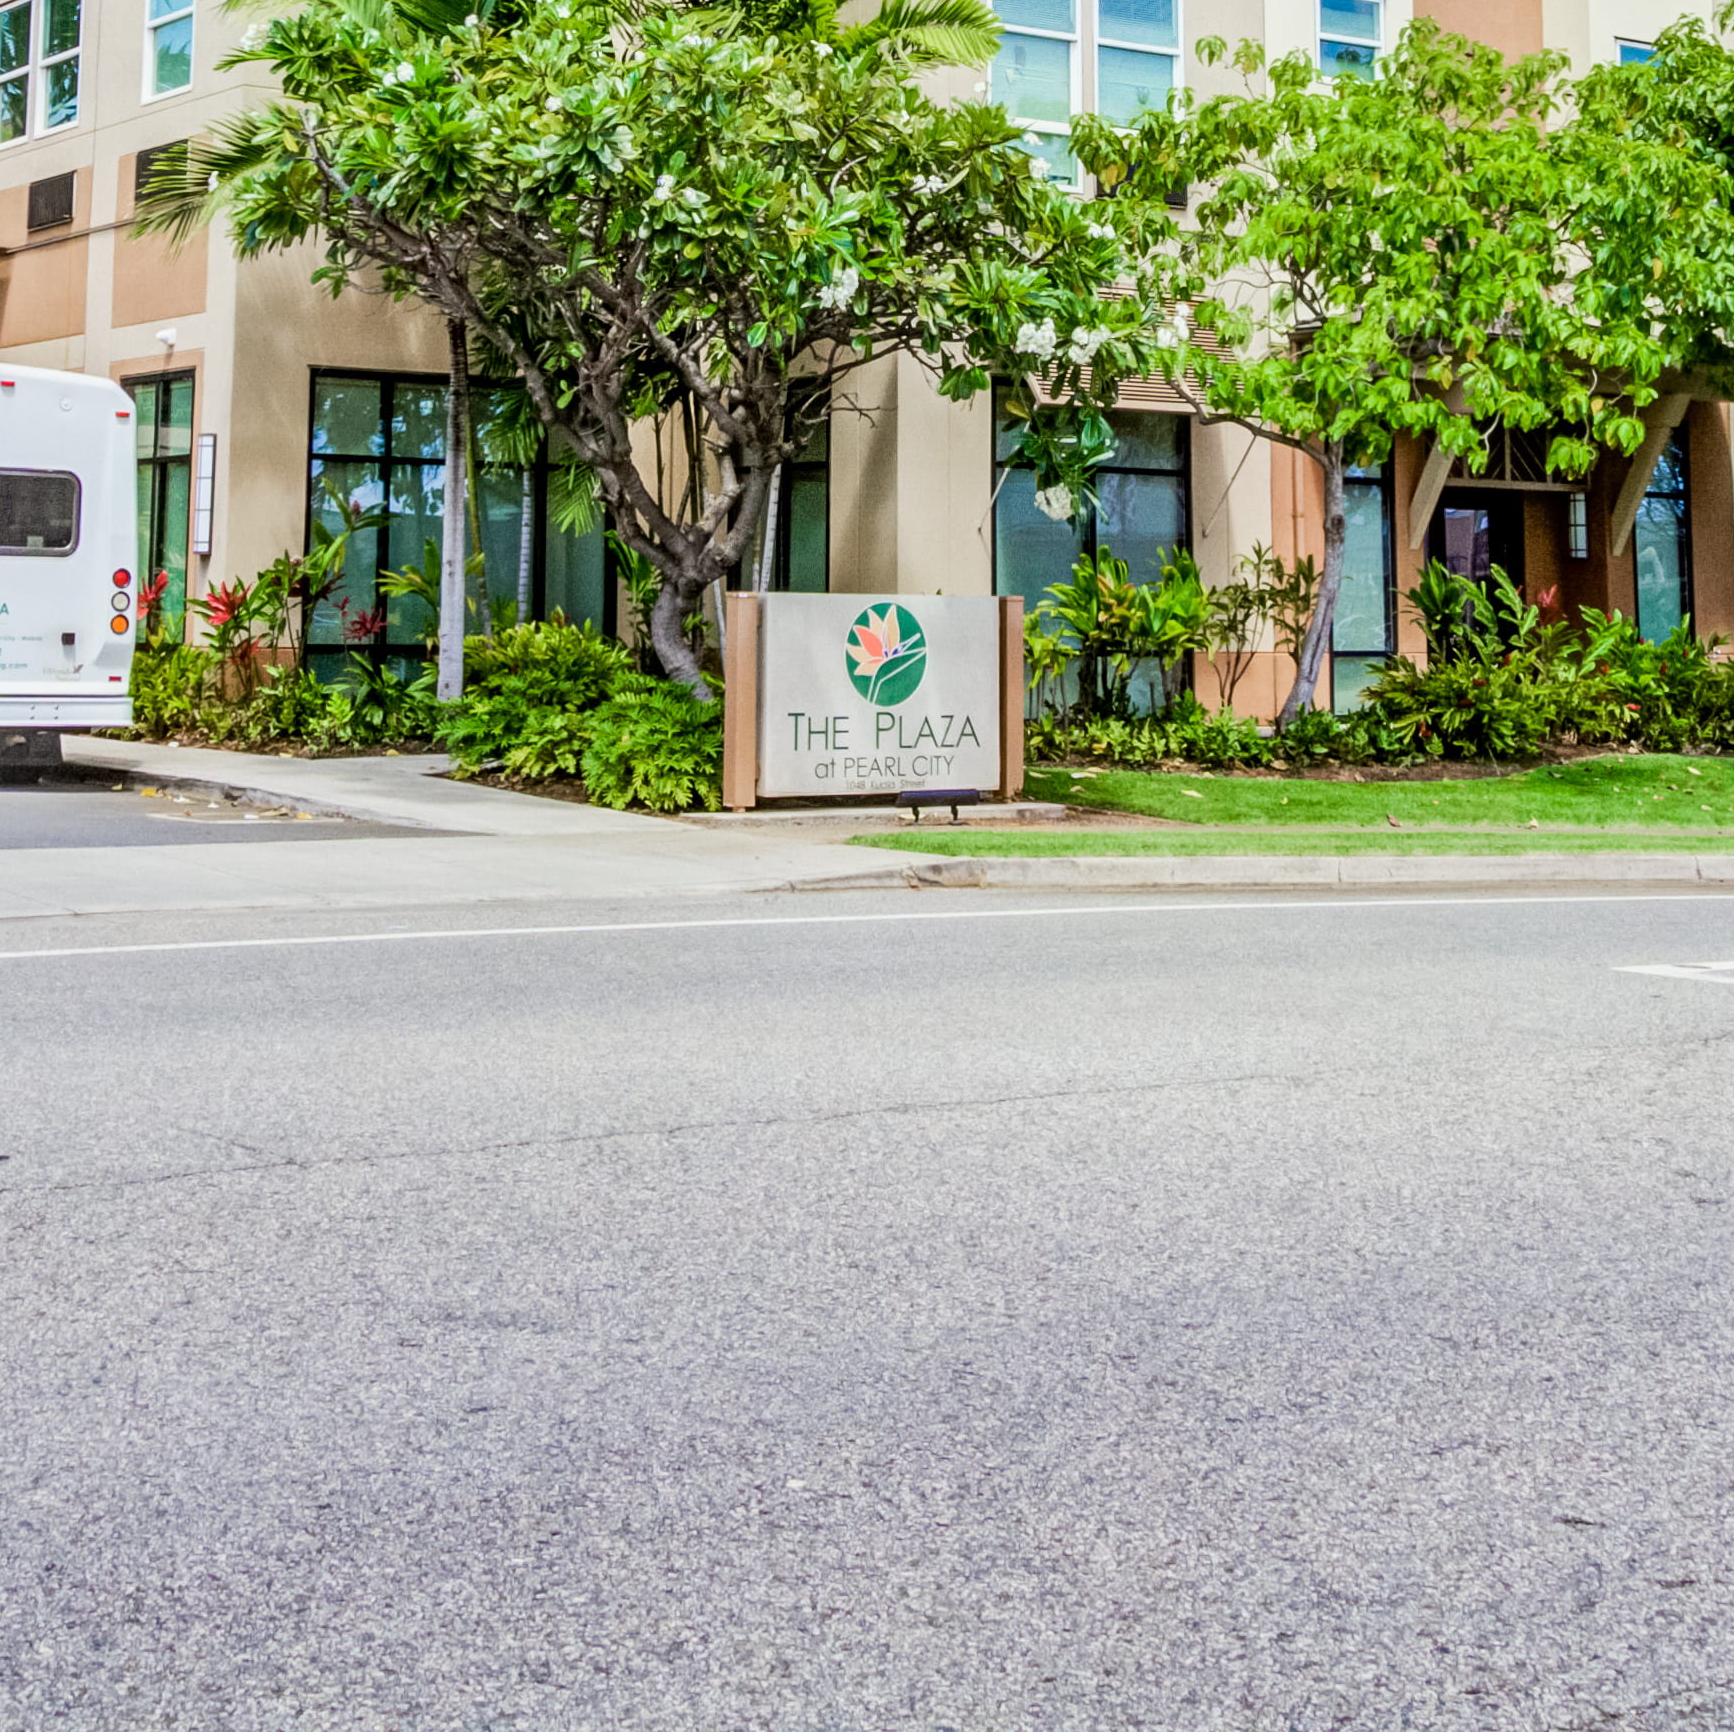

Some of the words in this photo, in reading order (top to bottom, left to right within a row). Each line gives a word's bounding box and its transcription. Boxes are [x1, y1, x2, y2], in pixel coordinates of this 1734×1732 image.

[787, 712, 849, 751] THE
[875, 711, 981, 750] PLAZA
[814, 758, 836, 779] at
[843, 756, 906, 778] PEARL
[912, 755, 955, 777] CITY
[846, 780, 865, 791] 1048
[901, 779, 926, 789] Street
